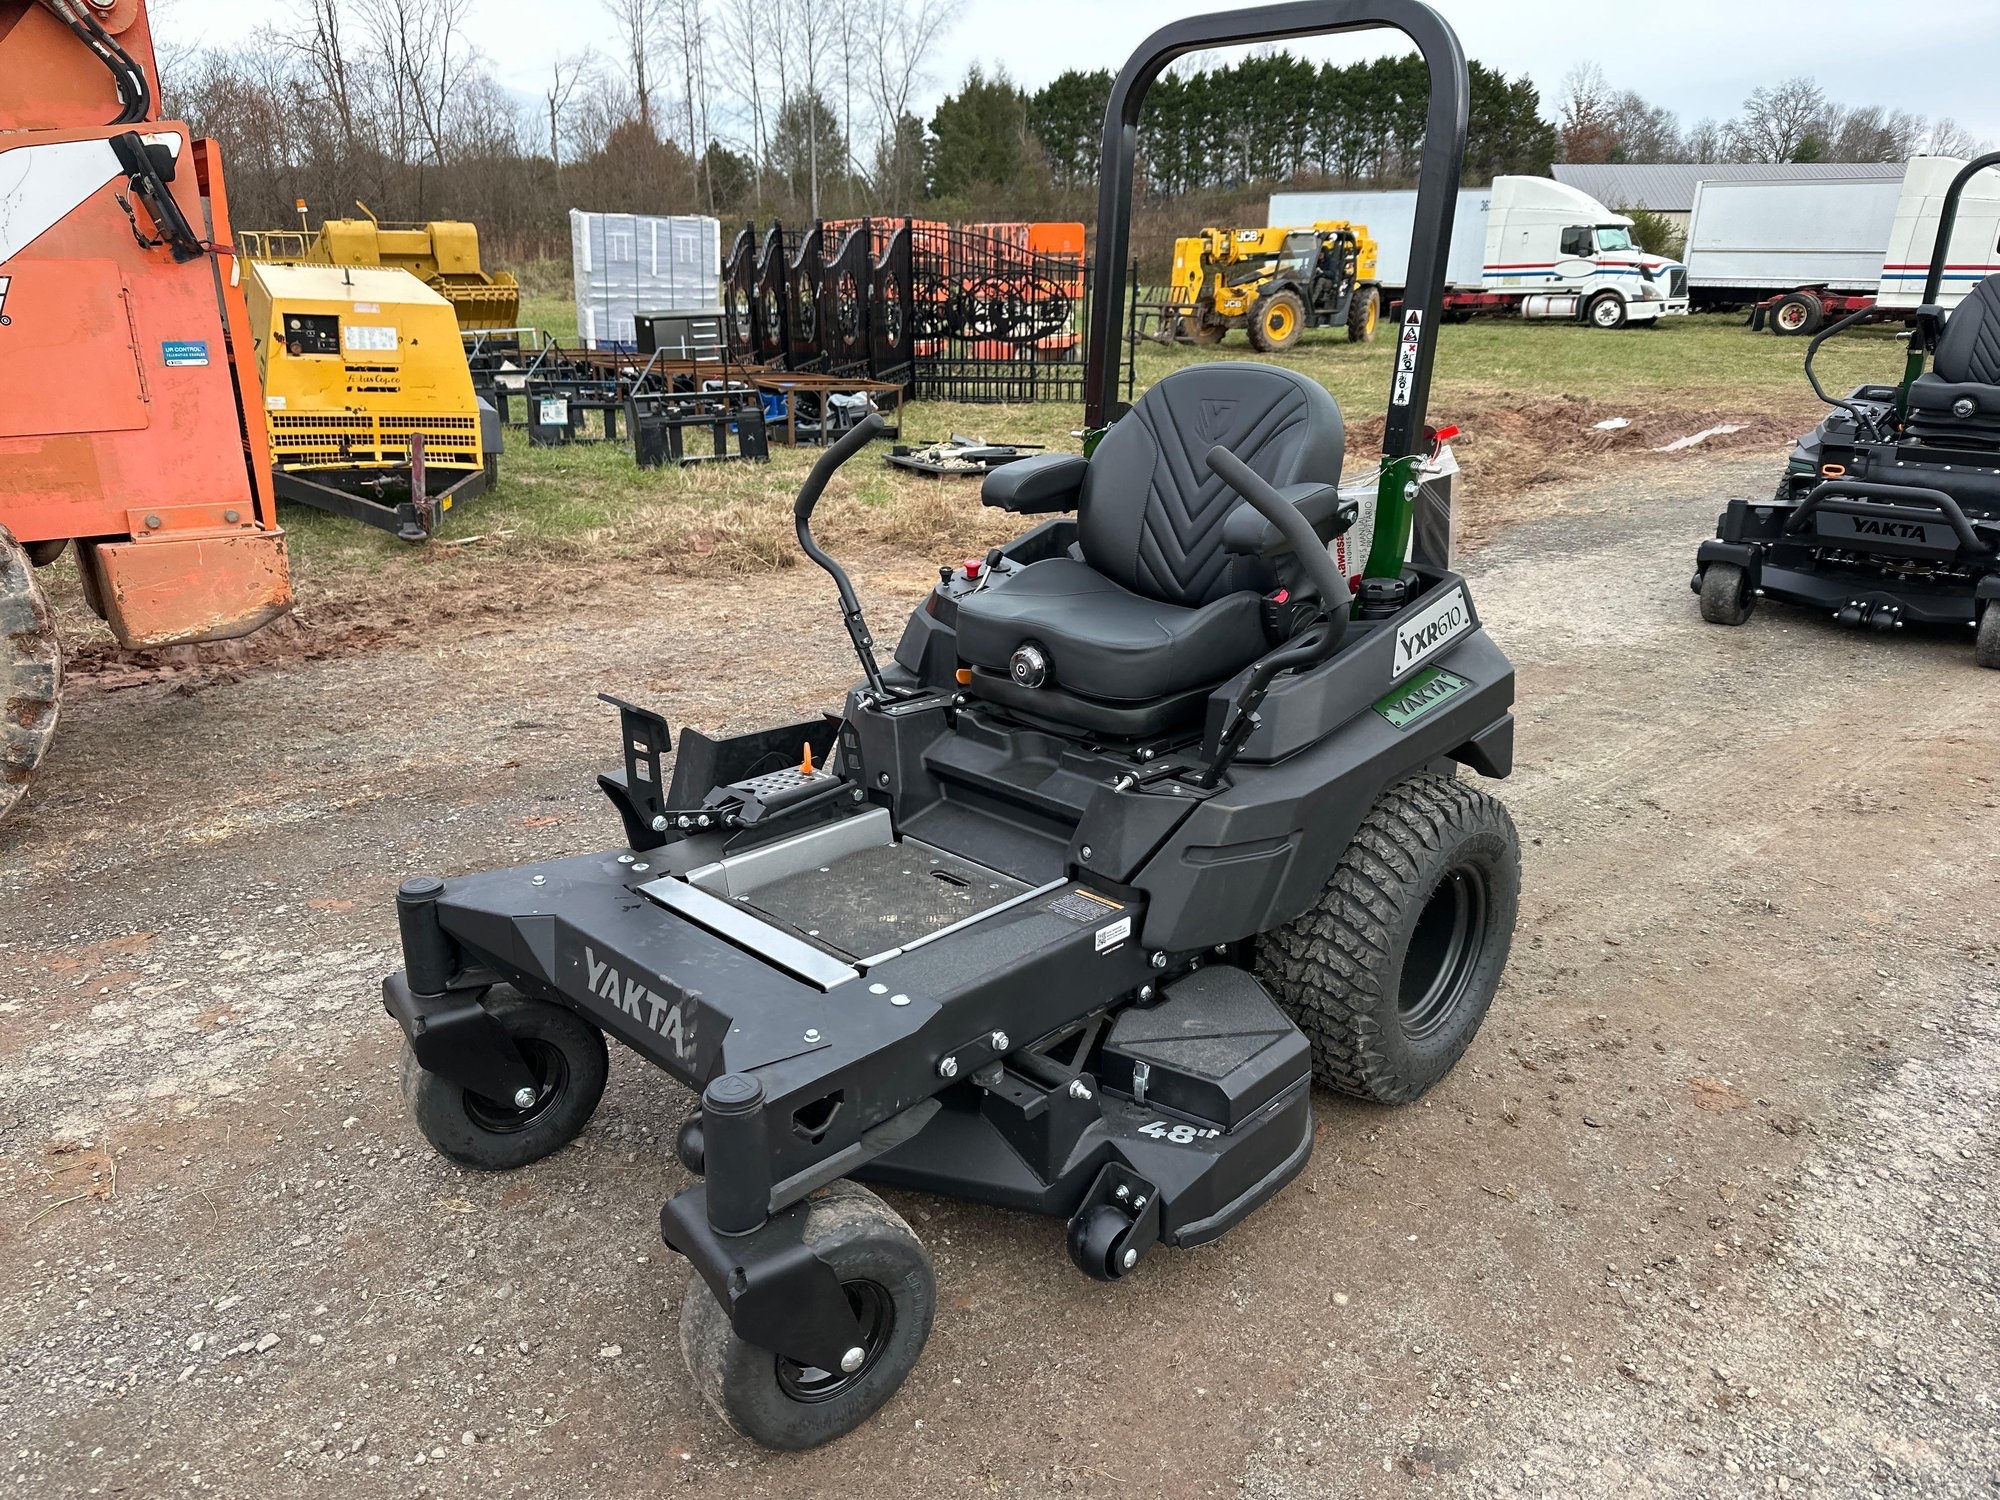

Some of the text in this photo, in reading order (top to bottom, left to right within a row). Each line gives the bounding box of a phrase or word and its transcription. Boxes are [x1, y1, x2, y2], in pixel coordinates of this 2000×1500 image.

[1237, 230, 1258, 242] JCB
[1224, 300, 1242, 308] JCB
[175, 345, 202, 353] CONTROL
[1852, 516, 1927, 543] YAKTA
[1400, 606, 1461, 661] YXR610
[1388, 678, 1458, 717] YAKTA
[585, 946, 684, 1058] YAKTA
